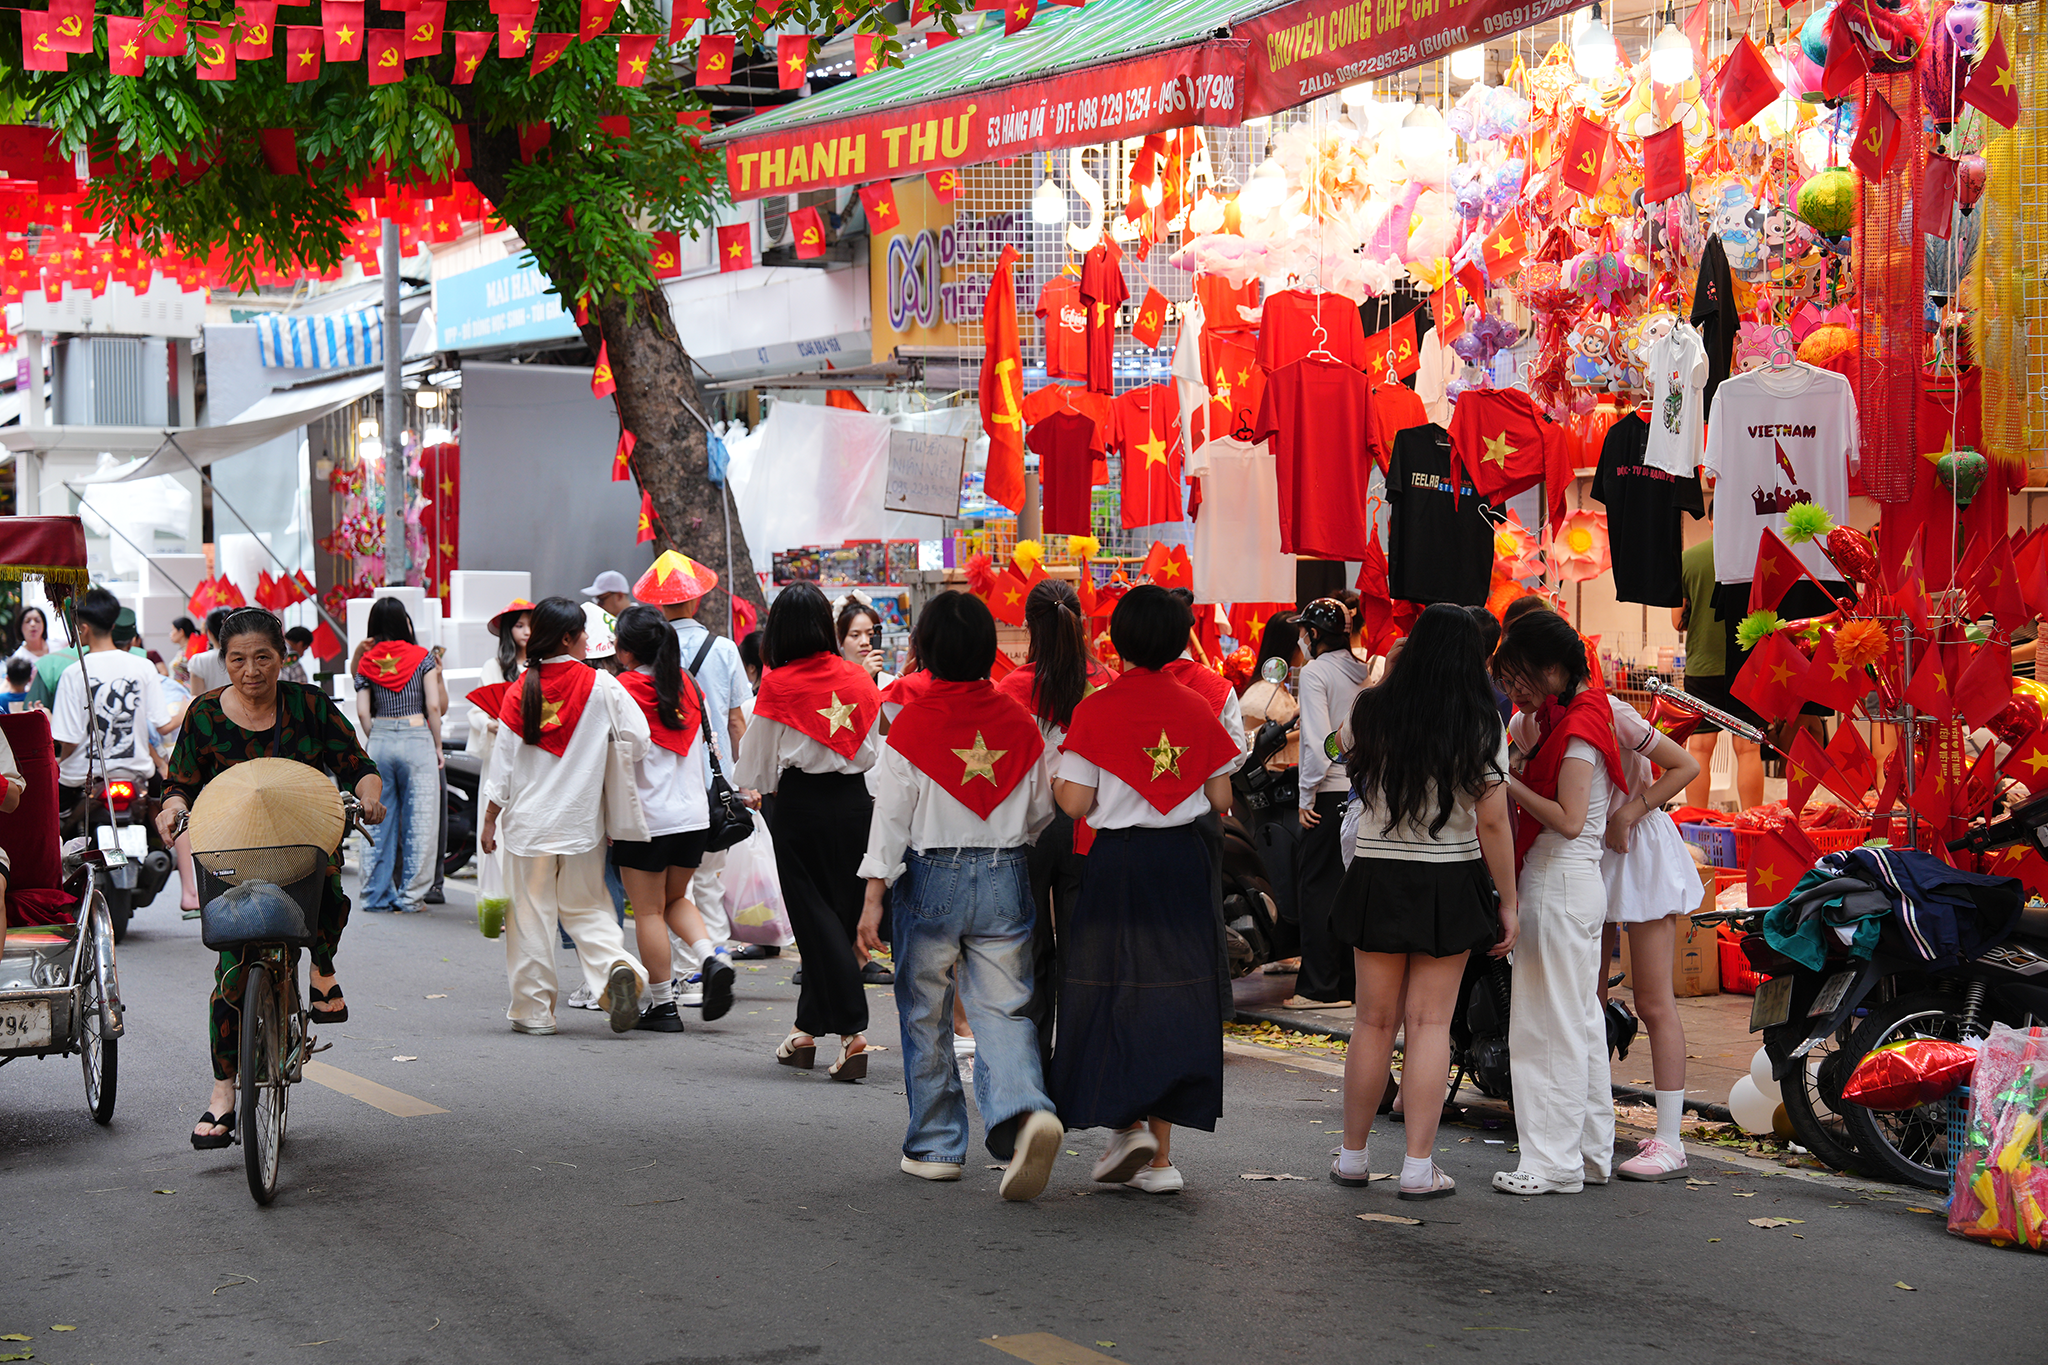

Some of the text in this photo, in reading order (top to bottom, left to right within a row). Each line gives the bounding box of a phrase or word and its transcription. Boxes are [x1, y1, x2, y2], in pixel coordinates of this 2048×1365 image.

[1266, 12, 1325, 73] CHUYÊN
[1328, 0, 1372, 51] CUNG
[1299, 72, 1336, 96] ZALO:
[1336, 43, 1417, 83] 0982295254
[1419, 25, 1469, 58] (BUÔN)
[737, 104, 977, 191] THANH THƯ
[987, 115, 1000, 147] 53
[1001, 105, 1028, 145] HÀNG
[1028, 99, 1048, 139] MÃ
[1077, 96, 1098, 130] 098
[1100, 91, 1122, 127] 229
[1124, 86, 1152, 122] 5254
[1747, 424, 1817, 439] VIETNAM
[1411, 472, 1440, 488] TEELAB
